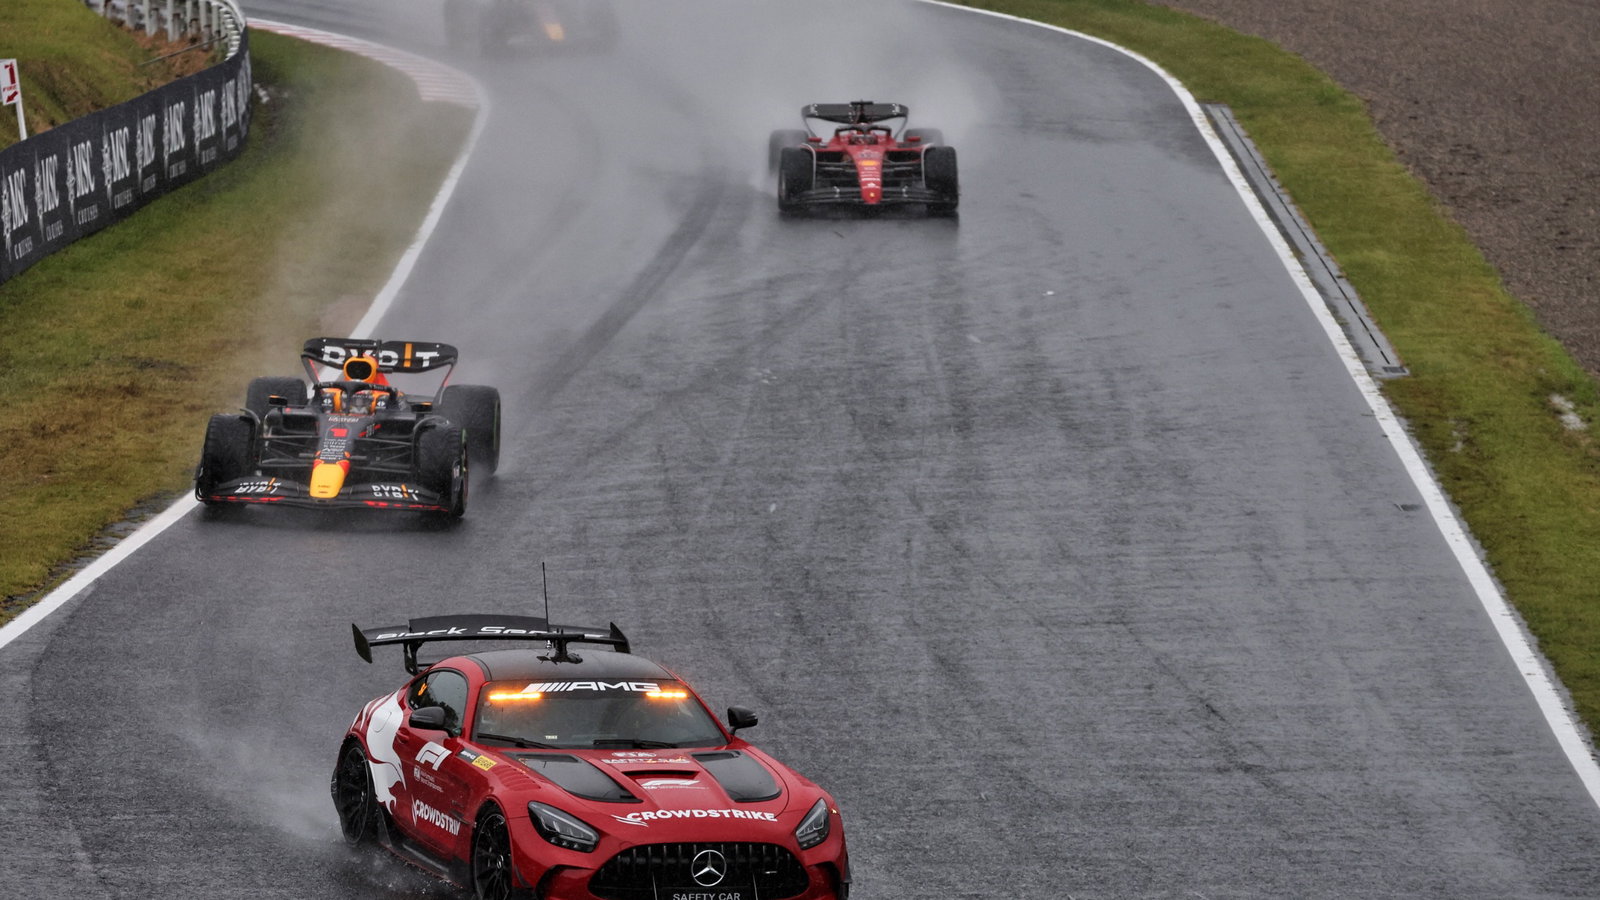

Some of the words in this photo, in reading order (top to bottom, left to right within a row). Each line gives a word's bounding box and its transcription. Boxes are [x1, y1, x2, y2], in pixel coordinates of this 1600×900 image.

[4, 62, 16, 84] 1
[567, 681, 662, 692] AMG
[626, 809, 778, 822] CROWDSTRIKE
